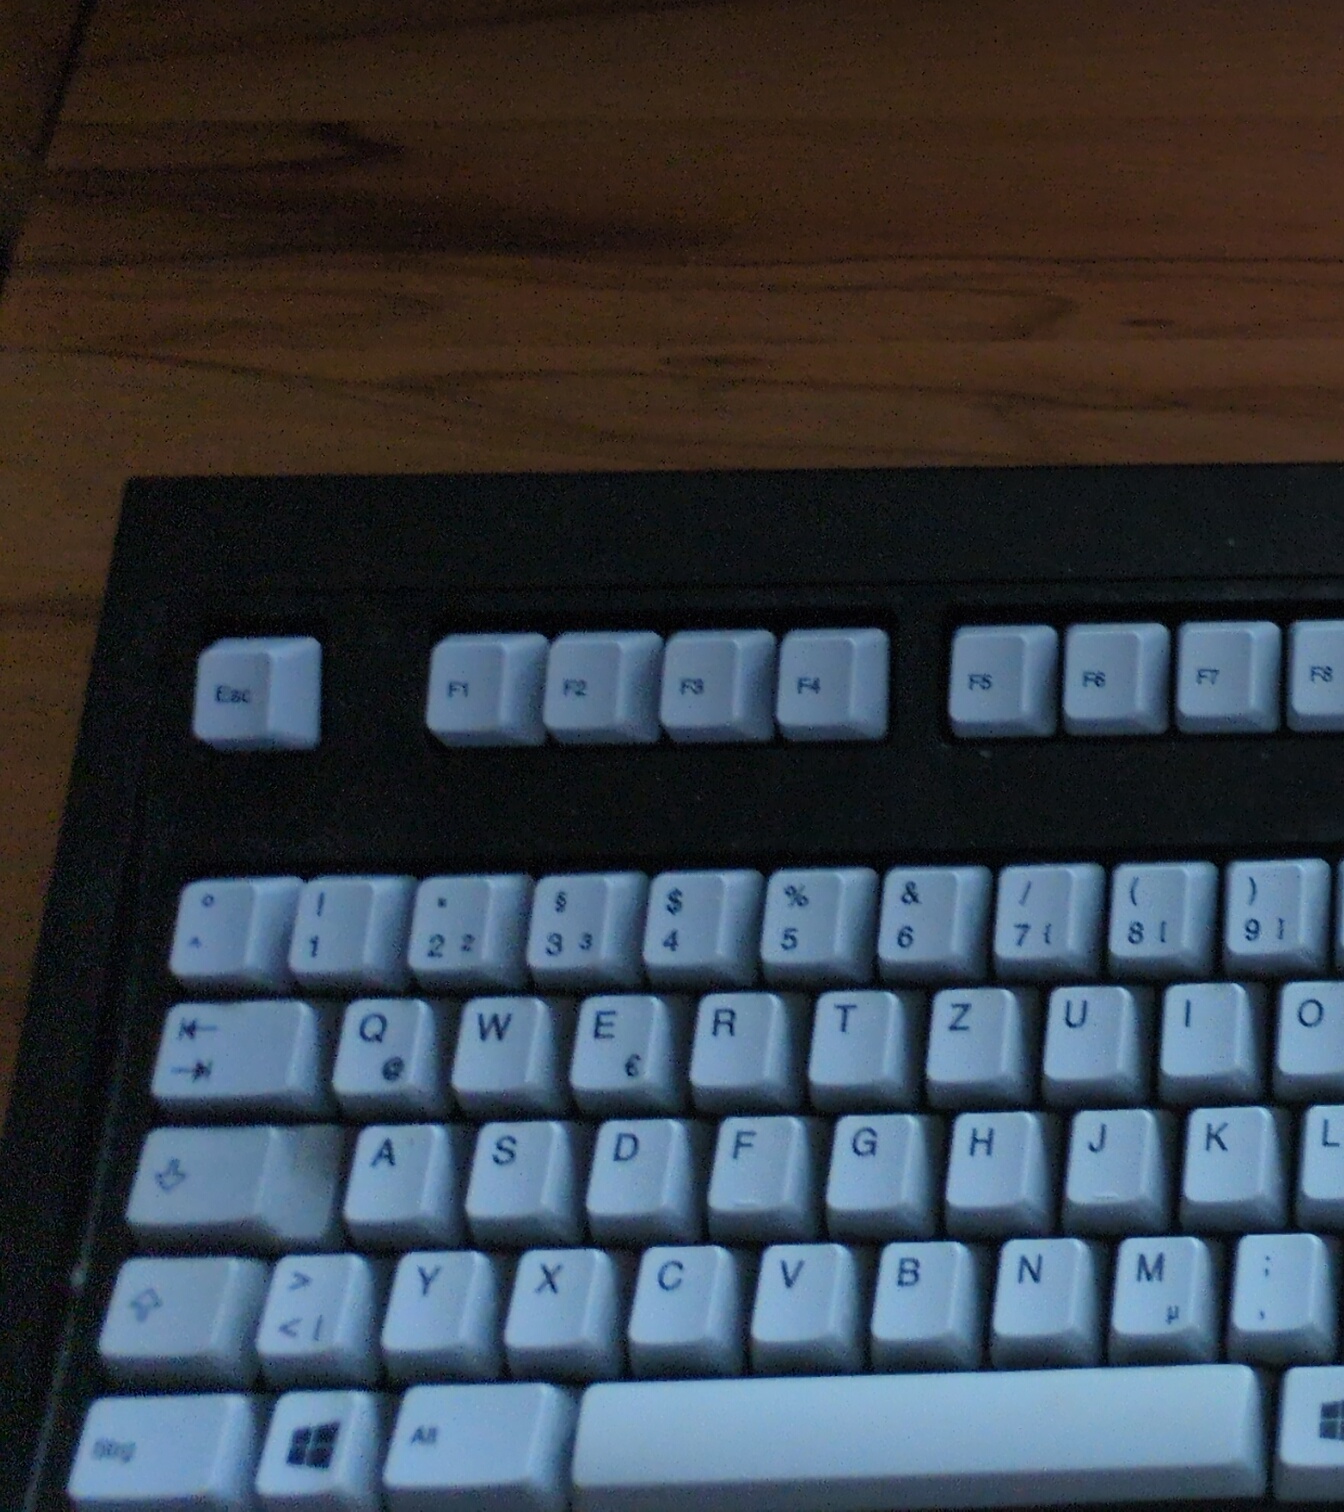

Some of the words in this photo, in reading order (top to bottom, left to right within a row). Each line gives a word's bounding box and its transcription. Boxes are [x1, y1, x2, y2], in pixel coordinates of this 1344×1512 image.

[969, 674, 992, 690] F5
[1083, 671, 1105, 687] F6
[1196, 668, 1219, 684] F7
[666, 889, 683, 915] $
[784, 884, 809, 908] %
[901, 882, 921, 904] &
[1019, 881, 1032, 906] /
[1130, 877, 1140, 906] (
[662, 930, 678, 952] 4
[780, 928, 798, 950] 5
[897, 926, 913, 949] 6
[1014, 923, 1030, 946] 7
[1128, 922, 1144, 944] 8
[1245, 919, 1260, 941] 9
[427, 934, 445, 958] 2
[546, 933, 562, 956] 3
[594, 1011, 616, 1040] E
[712, 1009, 736, 1036] R
[835, 1005, 857, 1033] T
[948, 1003, 971, 1031] Z
[1064, 1000, 1087, 1028] U
[1298, 999, 1324, 1027] O
[359, 1014, 387, 1043] Q
[478, 1014, 512, 1041] W
[613, 1133, 639, 1161] D
[732, 1131, 756, 1159] F
[852, 1128, 877, 1156] G
[970, 1128, 995, 1156] H
[1088, 1124, 1107, 1153] J
[1206, 1122, 1228, 1151] K
[1322, 1119, 1341, 1147] L
[371, 1138, 396, 1167] A
[492, 1135, 516, 1165] S
[290, 1272, 311, 1290] >
[418, 1266, 441, 1295] Y
[536, 1265, 562, 1294] X
[658, 1261, 684, 1291] C
[781, 1260, 804, 1288] V
[897, 1258, 920, 1287] B
[1018, 1254, 1042, 1283] N
[1137, 1253, 1164, 1282] M
[279, 1318, 301, 1338] <
